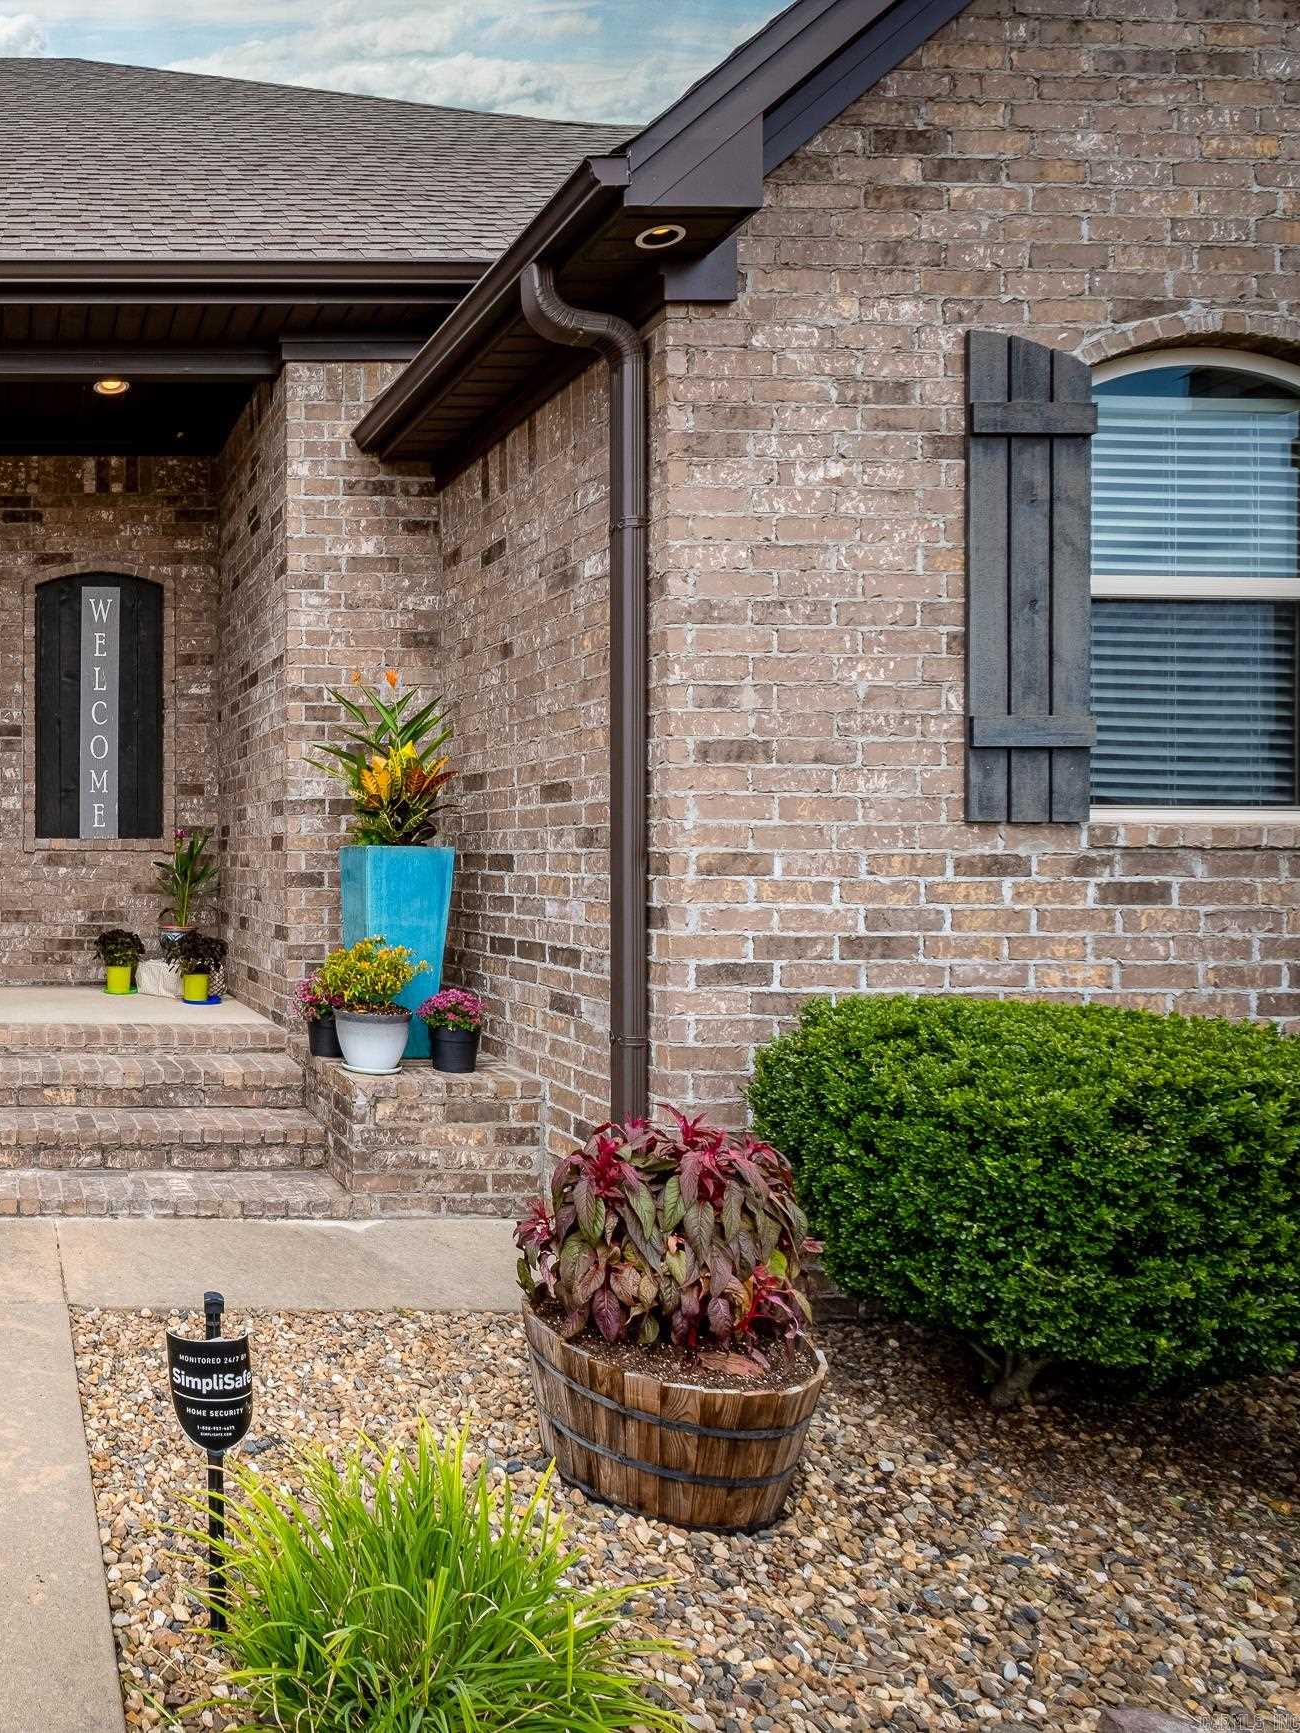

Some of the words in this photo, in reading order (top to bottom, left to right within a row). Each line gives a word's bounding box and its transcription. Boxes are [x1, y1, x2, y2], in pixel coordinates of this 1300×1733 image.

[89, 598, 113, 827] WELCOME
[179, 1354, 221, 1364] MONITORED
[223, 1356, 239, 1364] 24/7
[172, 1367, 252, 1394] SimpliSafe
[186, 1407, 207, 1417] HOME
[209, 1407, 244, 1417] SECURITY
